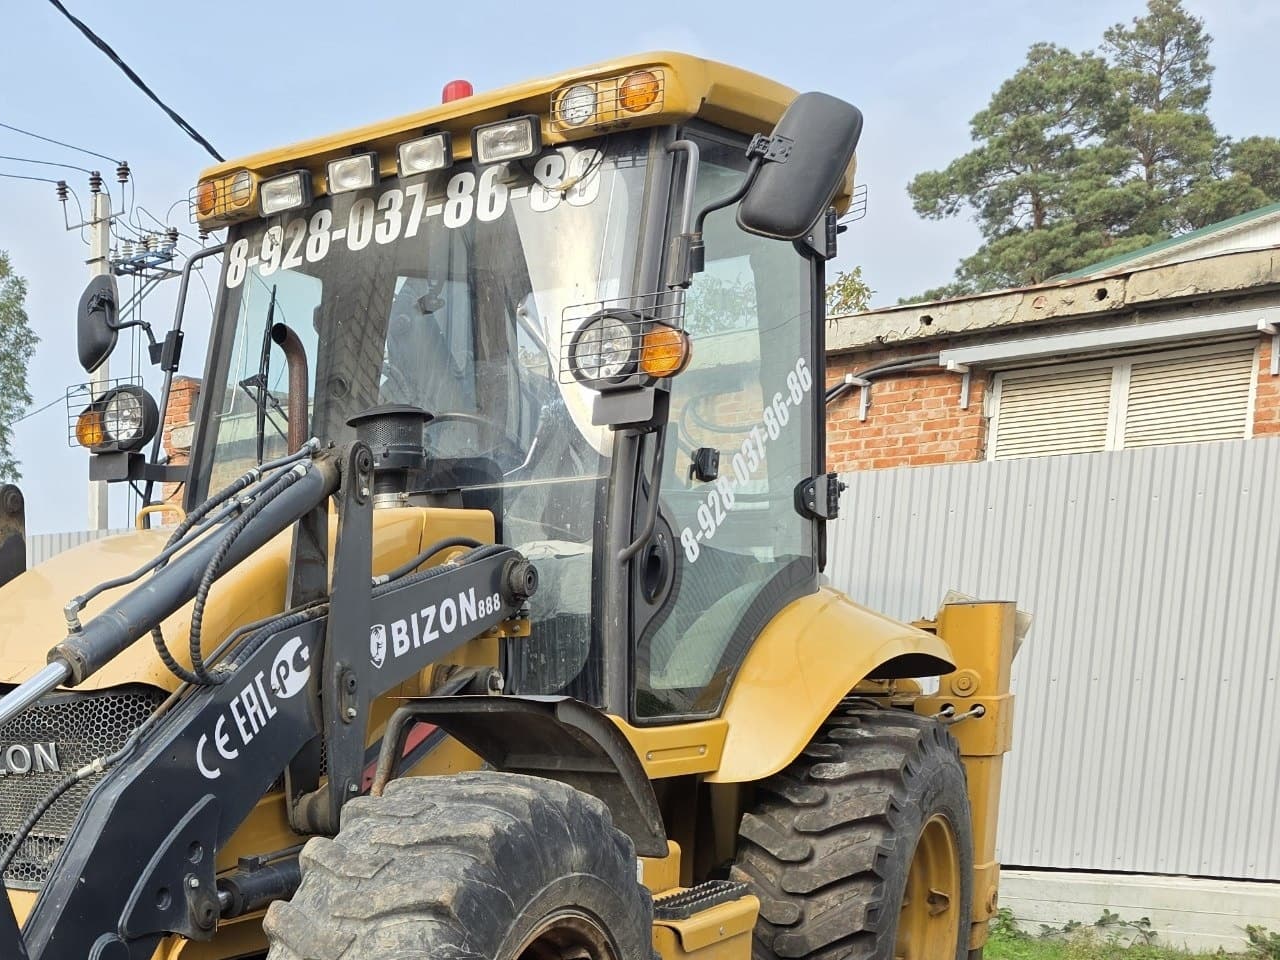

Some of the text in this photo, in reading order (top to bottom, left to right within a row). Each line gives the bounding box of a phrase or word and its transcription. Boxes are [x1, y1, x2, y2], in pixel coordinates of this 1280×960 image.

[680, 357, 812, 564] 8-928-037-86-86
[391, 587, 501, 658] BIZON 888
[196, 714, 239, 780] CE
